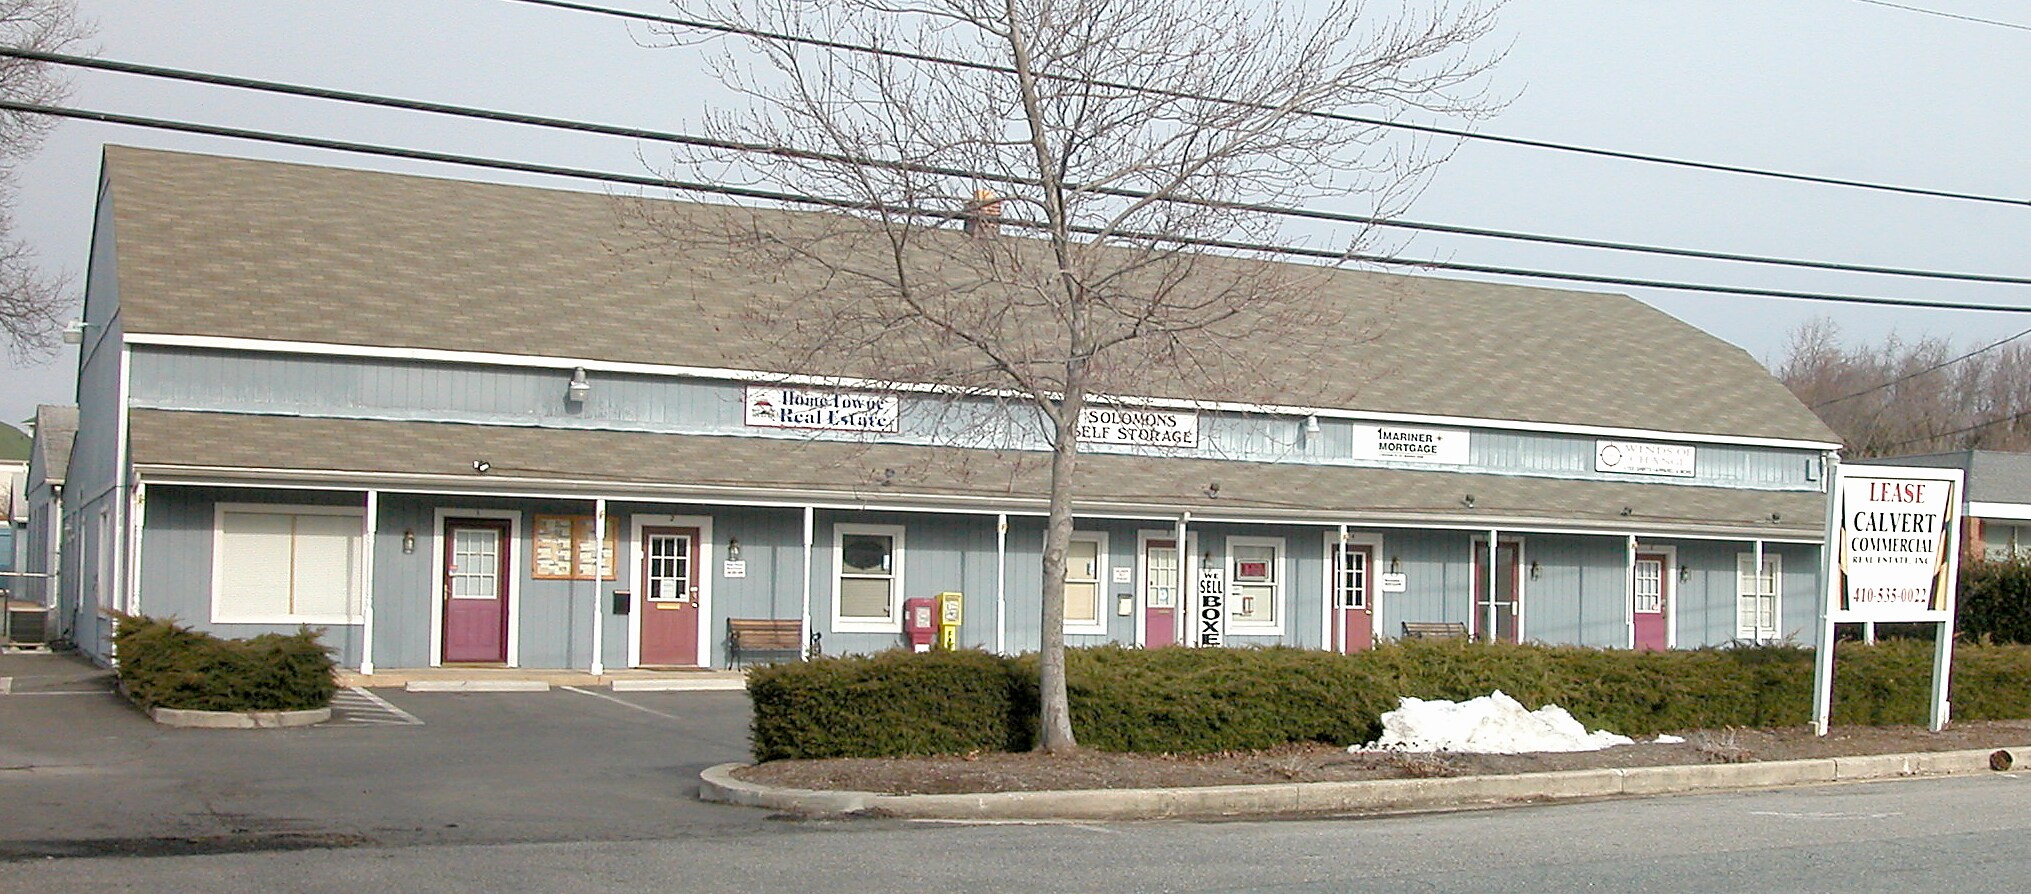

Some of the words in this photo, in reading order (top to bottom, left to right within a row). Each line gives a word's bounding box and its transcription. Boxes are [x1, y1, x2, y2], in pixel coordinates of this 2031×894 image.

[780, 408, 821, 424] Real
[828, 411, 887, 427] Estate
[1088, 411, 1177, 428] SOLOMONS
[1117, 427, 1192, 443] STORAGE
[1378, 443, 1438, 454] MORTGAGE
[1869, 482, 1926, 504] LEASE
[1853, 511, 1937, 533] CALVERT
[1851, 537, 1934, 553] COMMERCIAL
[1852, 556, 1873, 564] REAL
[1200, 580, 1223, 594] SELL
[1853, 587, 1927, 603] 410-535-0022
[1201, 595, 1222, 647] BOXE
